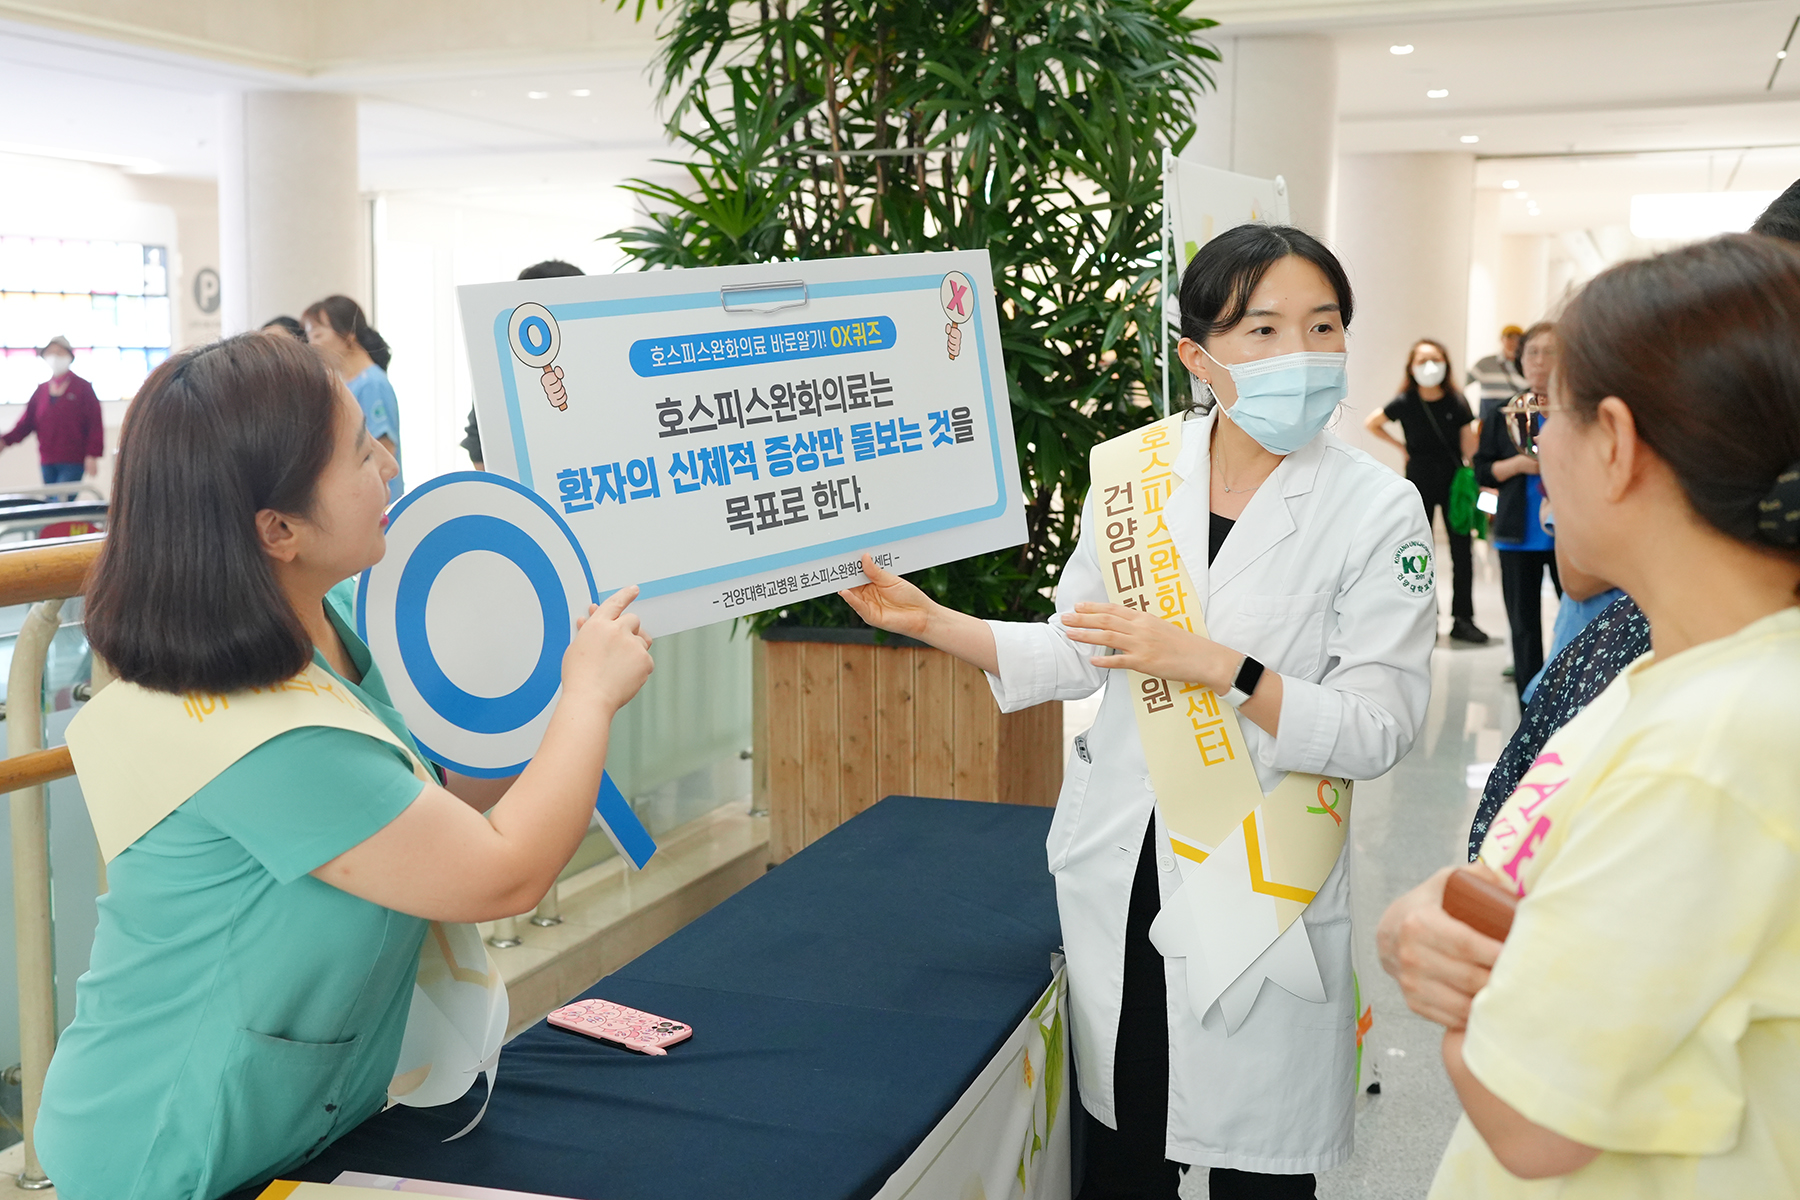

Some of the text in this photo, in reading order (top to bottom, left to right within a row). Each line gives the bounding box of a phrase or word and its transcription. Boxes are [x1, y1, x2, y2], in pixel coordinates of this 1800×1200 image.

[650, 321, 883, 367] 호스피스완화의료 바로알기! OX퀴즈
[655, 371, 894, 438] 호스피스완화의료는
[556, 406, 975, 514] 환자의 신체적 증상만 돌보는 것을
[725, 475, 870, 535] 목표로 한다.
[722, 576, 798, 608] 건양대학교병원
[800, 553, 892, 589] 호스피스완화의센터
[1139, 425, 1235, 766] 호스피스완화센터
[1402, 555, 1428, 574] KY
[1103, 482, 1174, 714] 건양대원
